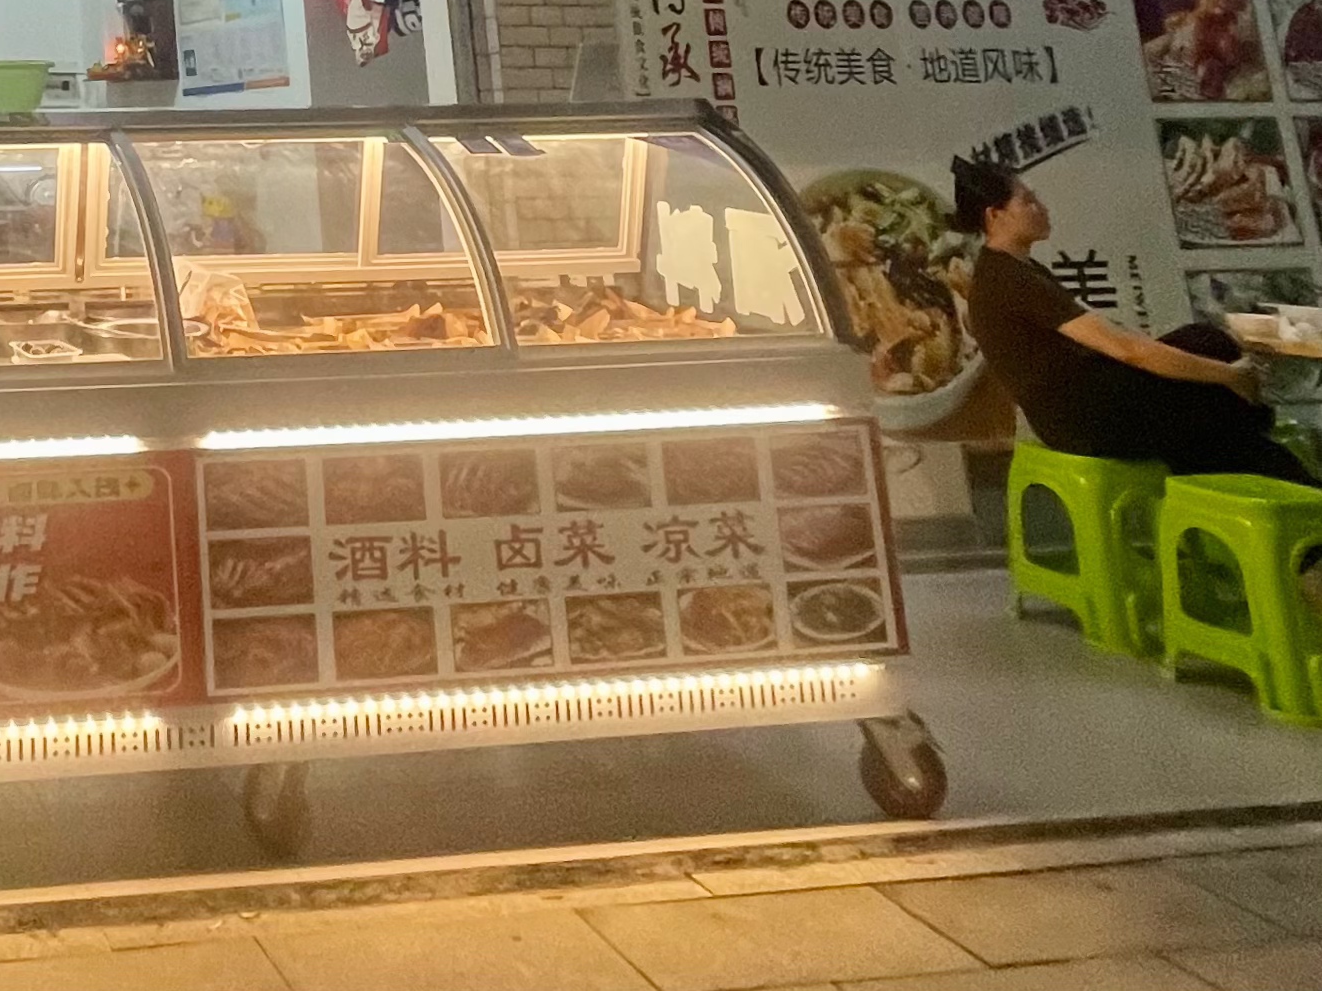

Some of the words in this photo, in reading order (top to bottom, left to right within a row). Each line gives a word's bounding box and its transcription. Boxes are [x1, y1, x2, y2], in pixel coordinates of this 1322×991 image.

[328, 530, 462, 581] 酒料
[493, 524, 614, 570] 卤菜
[640, 511, 766, 560] 凉菜
